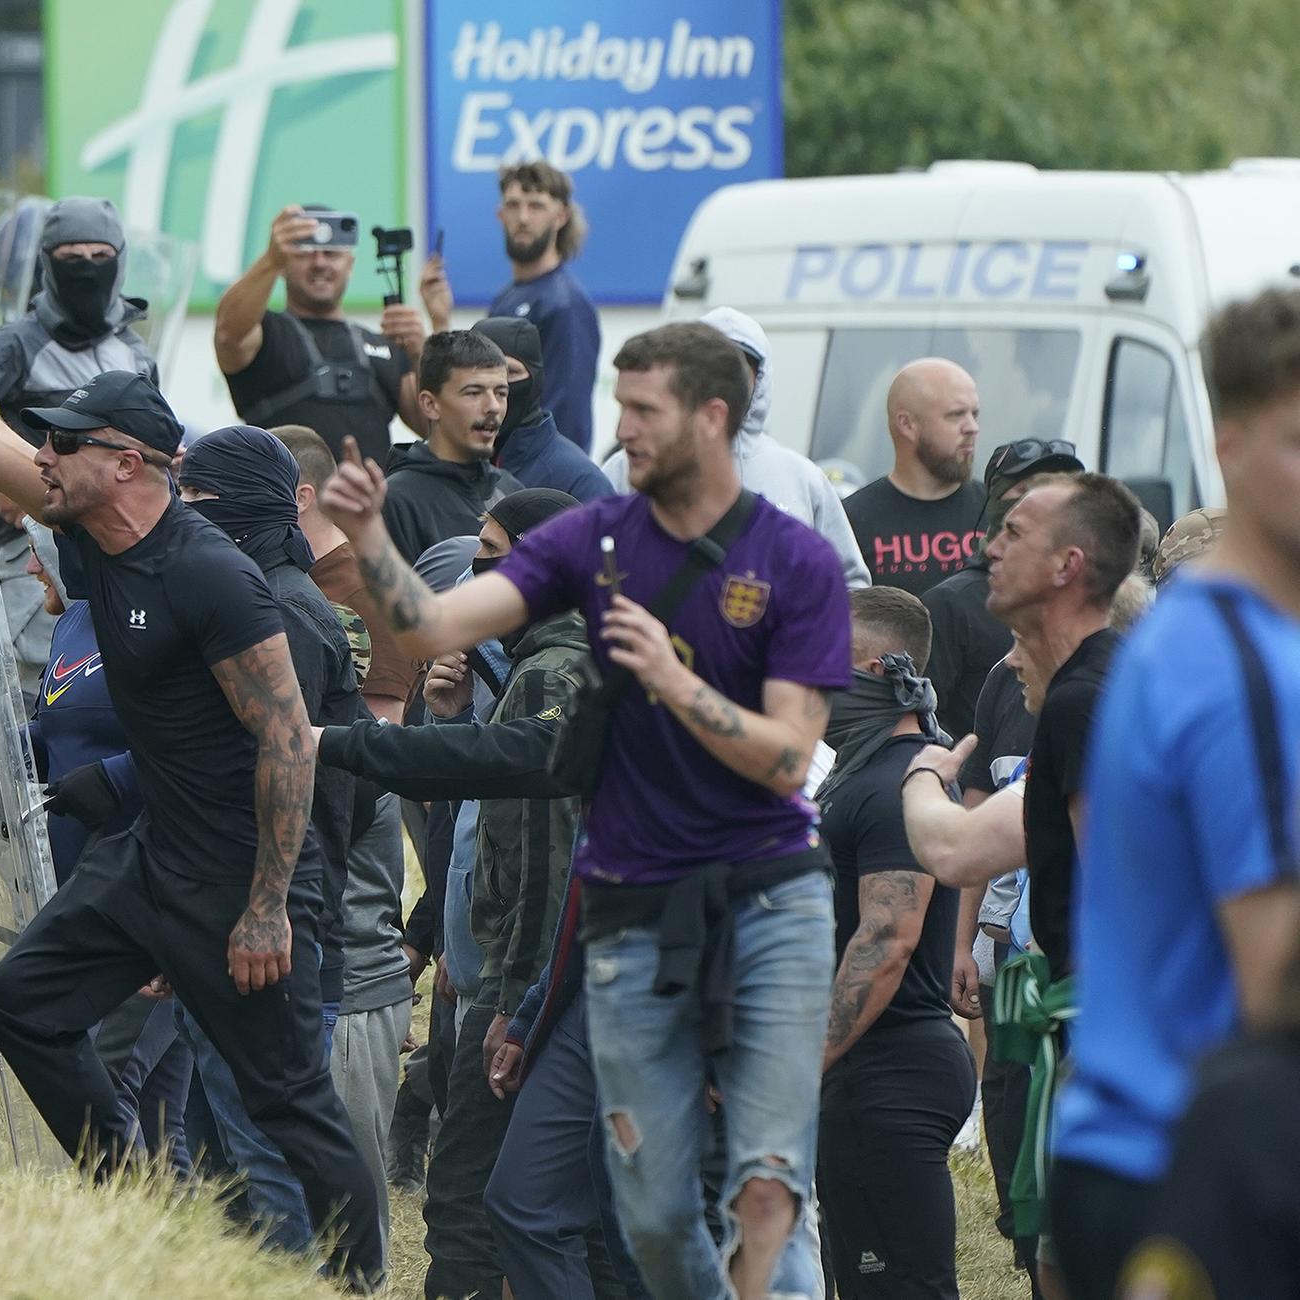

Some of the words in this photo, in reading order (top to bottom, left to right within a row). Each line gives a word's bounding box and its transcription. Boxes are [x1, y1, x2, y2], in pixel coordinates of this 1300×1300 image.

[452, 19, 664, 93] Holiday
[666, 18, 755, 80] Inn
[453, 91, 754, 172] Express
[785, 240, 1090, 300] POLICE
